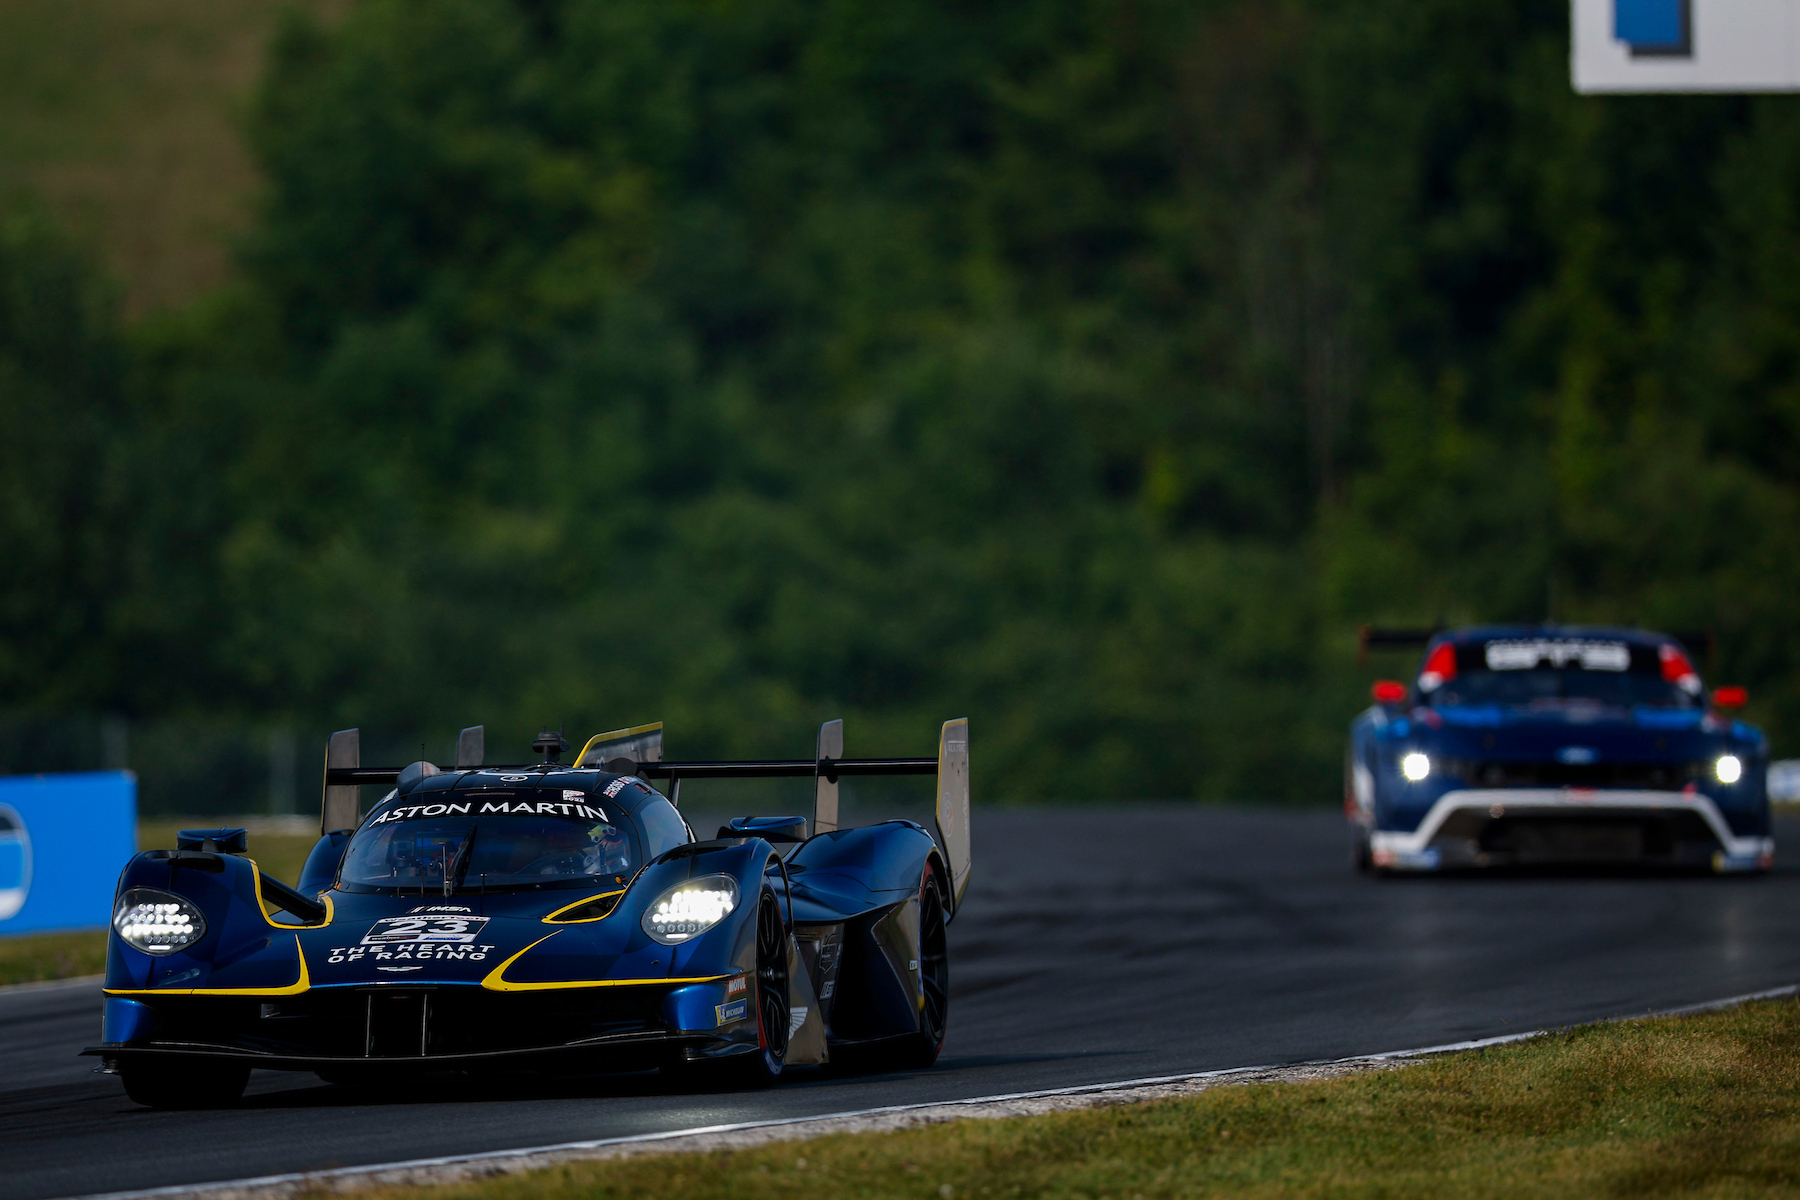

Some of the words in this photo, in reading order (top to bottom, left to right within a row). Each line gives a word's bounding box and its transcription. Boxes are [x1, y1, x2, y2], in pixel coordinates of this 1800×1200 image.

[369, 802, 471, 828] ASTON
[480, 802, 609, 823] MARTIN
[381, 920, 470, 935] 23
[327, 953, 365, 963] OF
[375, 951, 486, 961] RACING
[330, 945, 386, 955] THE
[397, 944, 495, 952] HEART
[729, 976, 746, 992] MOTUL
